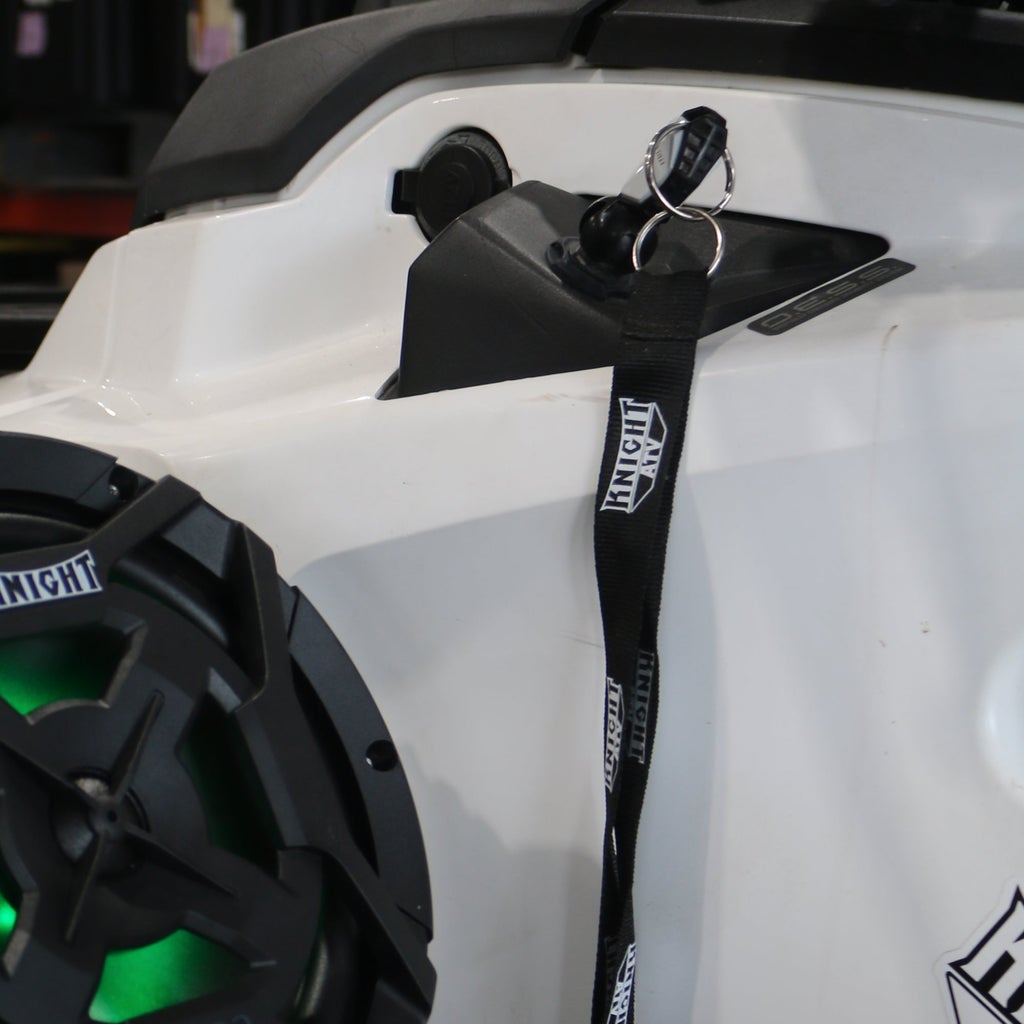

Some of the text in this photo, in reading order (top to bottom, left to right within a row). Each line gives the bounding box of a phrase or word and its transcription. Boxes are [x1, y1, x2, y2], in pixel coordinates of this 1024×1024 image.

[603, 399, 651, 510] KNIGHT
[638, 437, 663, 479] ATV
[633, 650, 655, 764] KNIGHT
